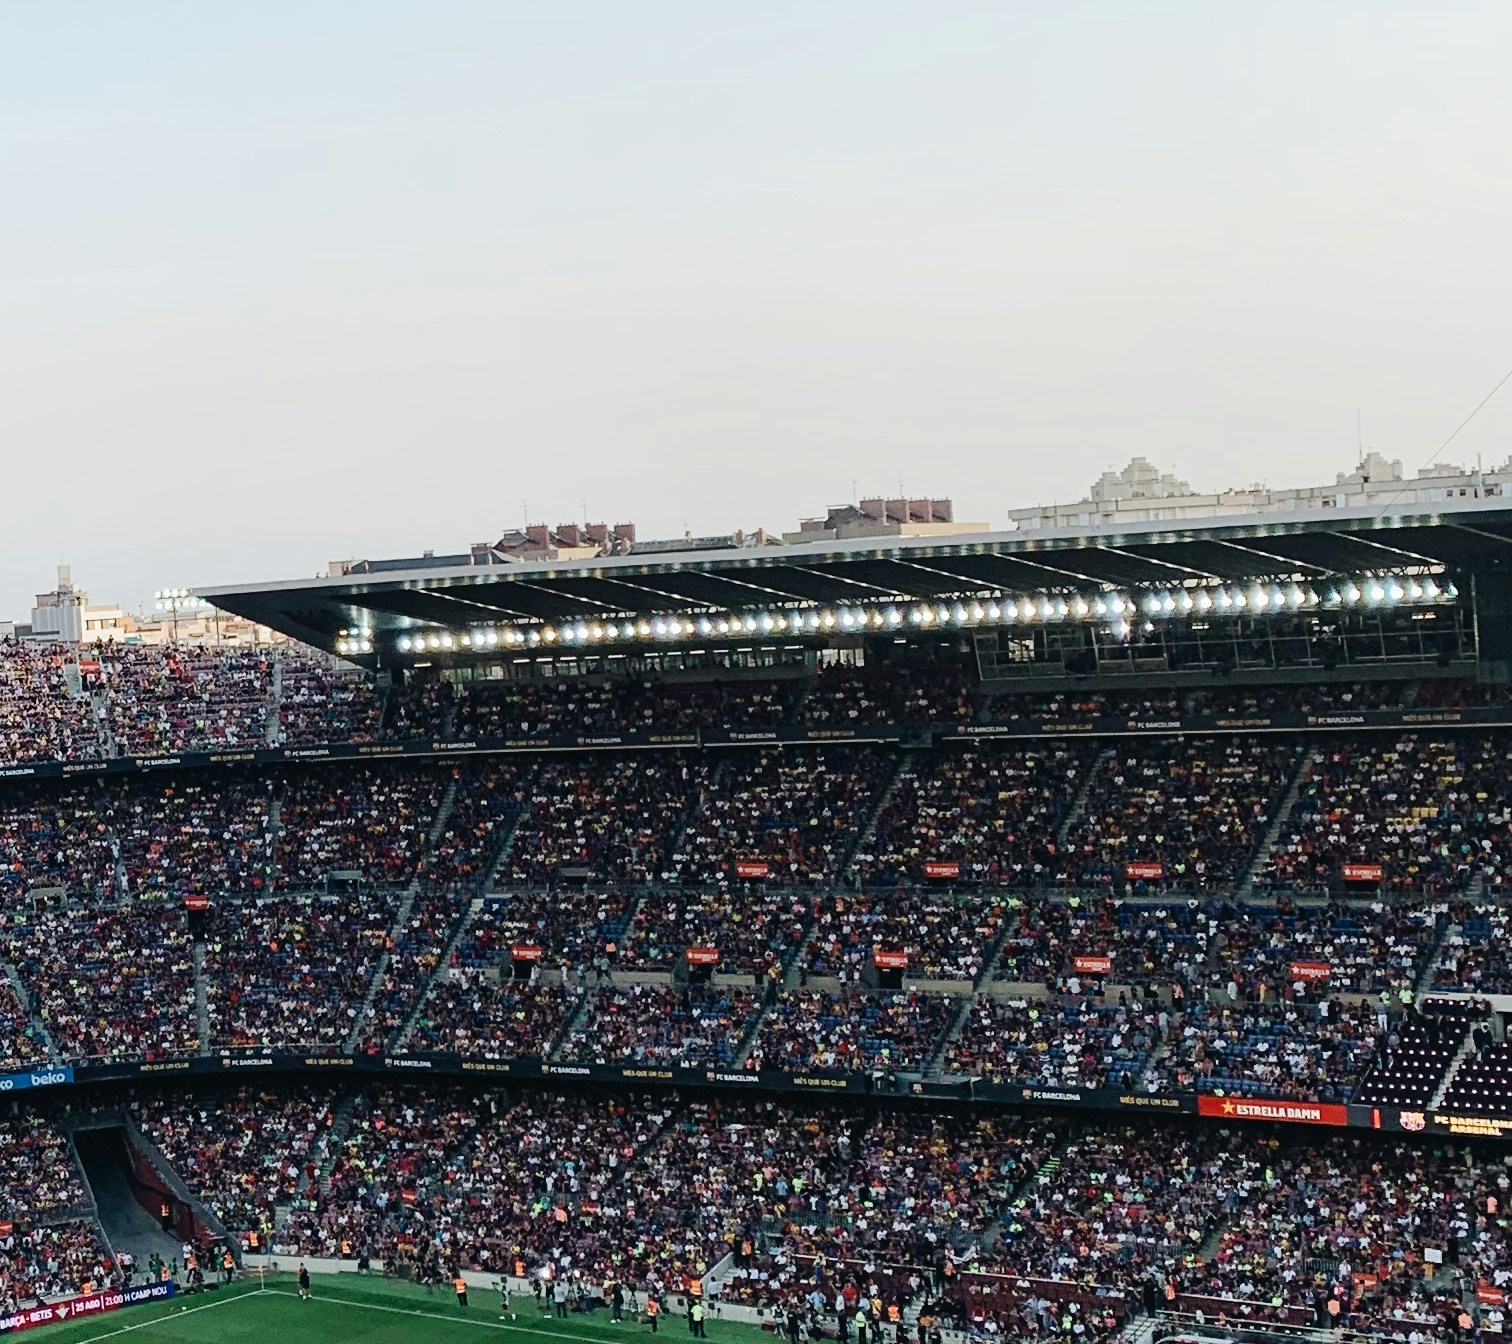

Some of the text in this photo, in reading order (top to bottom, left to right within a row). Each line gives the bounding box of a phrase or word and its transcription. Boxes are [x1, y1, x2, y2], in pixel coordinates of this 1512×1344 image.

[6, 768, 34, 776] BARCELONA
[239, 1058, 273, 1066] BARCELONA
[401, 1060, 431, 1068] BARCELONA
[557, 1067, 590, 1075] BARCELONA
[31, 1072, 65, 1086] beko
[724, 1074, 759, 1083] BARCELONA
[1042, 1092, 1081, 1101] BARCELONA
[1236, 1104, 1321, 1120] ESTRELLA DAMM
[1450, 1124, 1503, 1137] ARSENAL
[0, 1285, 168, 1331] BARÇA BETIS 25 AGO 21:00 H CAMP NOU
